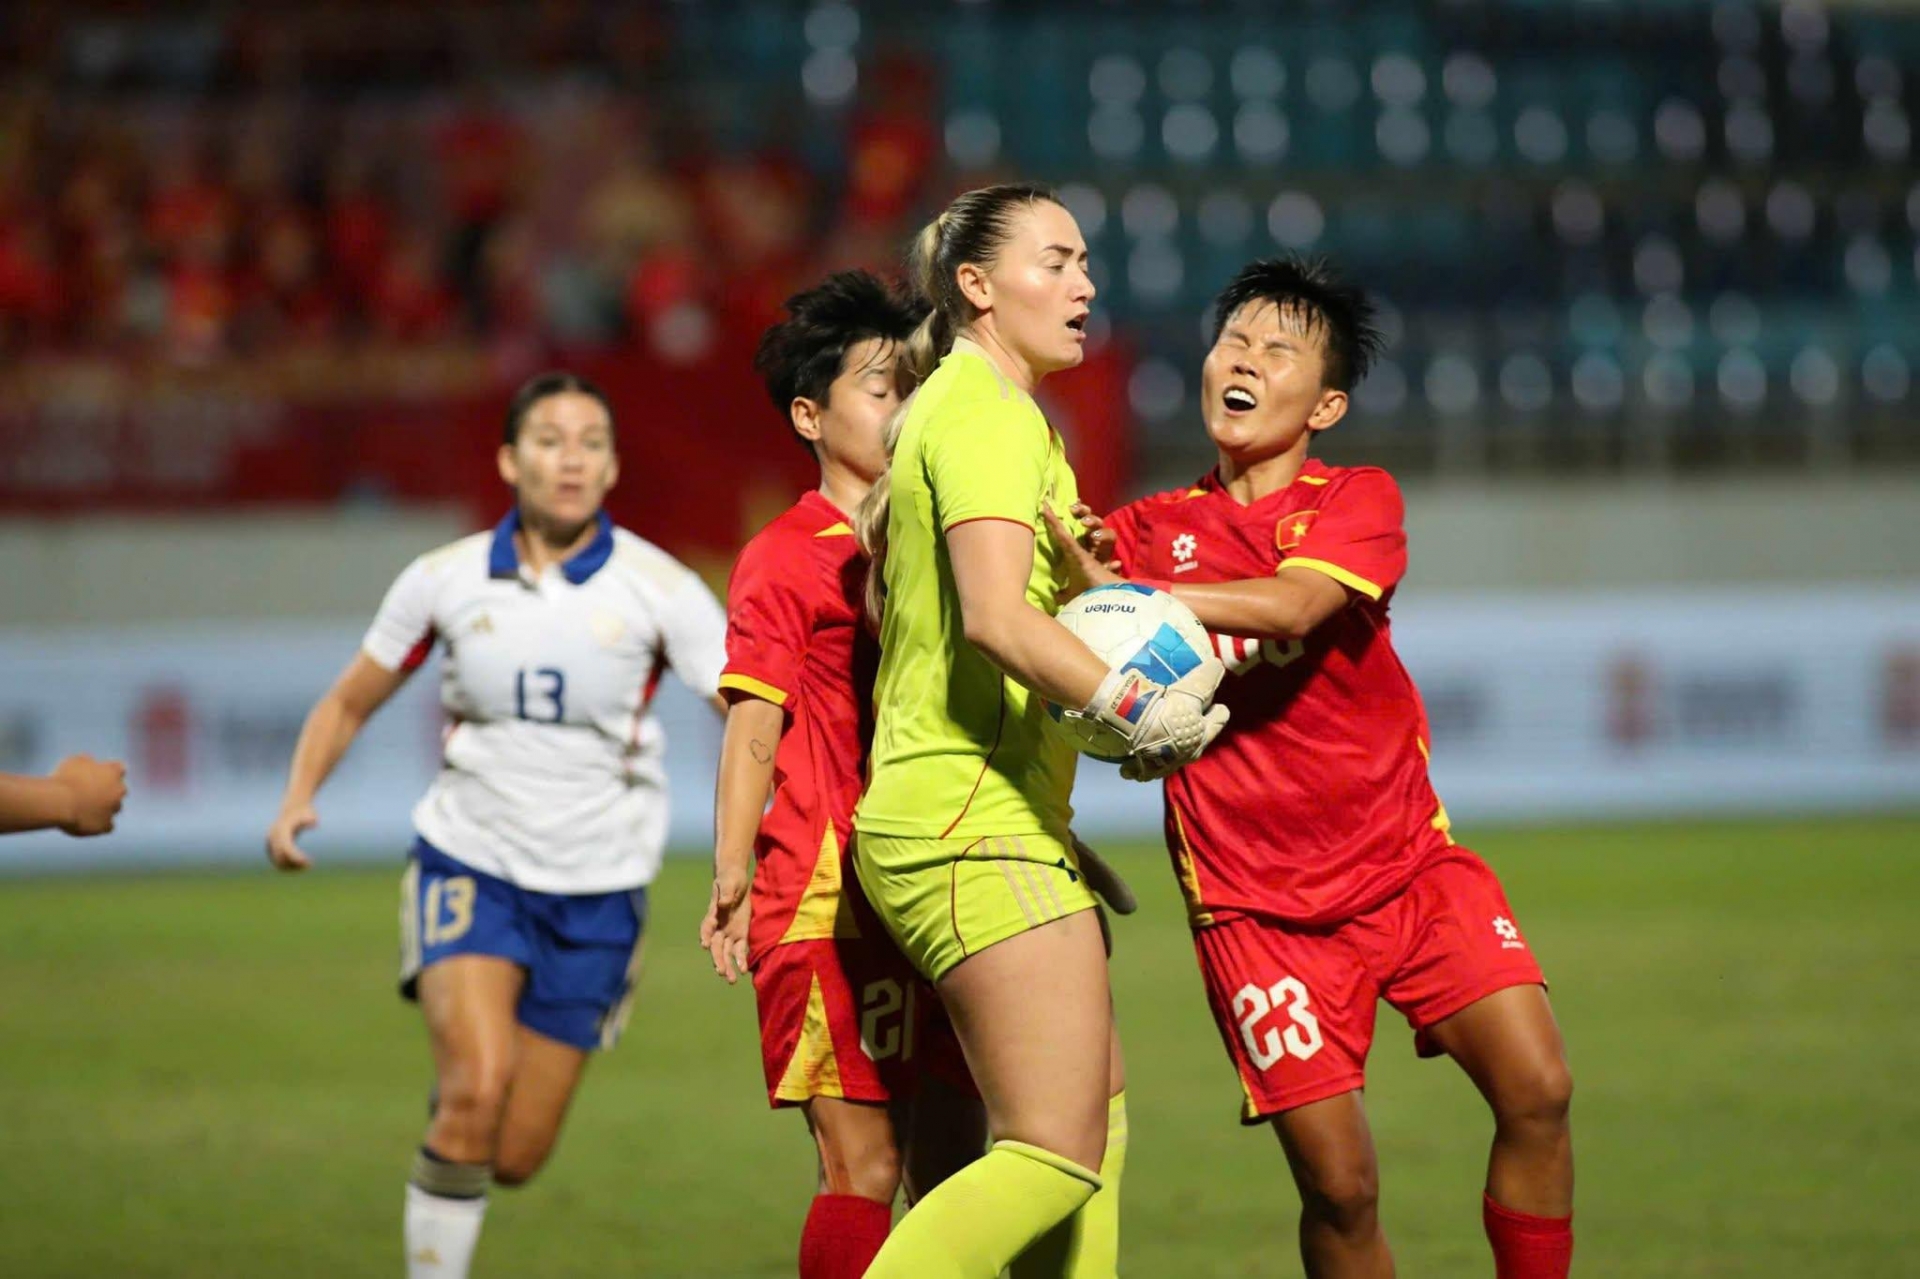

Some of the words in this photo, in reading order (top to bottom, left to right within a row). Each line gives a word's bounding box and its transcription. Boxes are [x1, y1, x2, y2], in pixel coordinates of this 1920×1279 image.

[1085, 603, 1136, 614] molten
[515, 666, 565, 723] 13
[425, 876, 475, 945] 13
[860, 977, 916, 1062] 21
[1232, 975, 1324, 1072] 23
